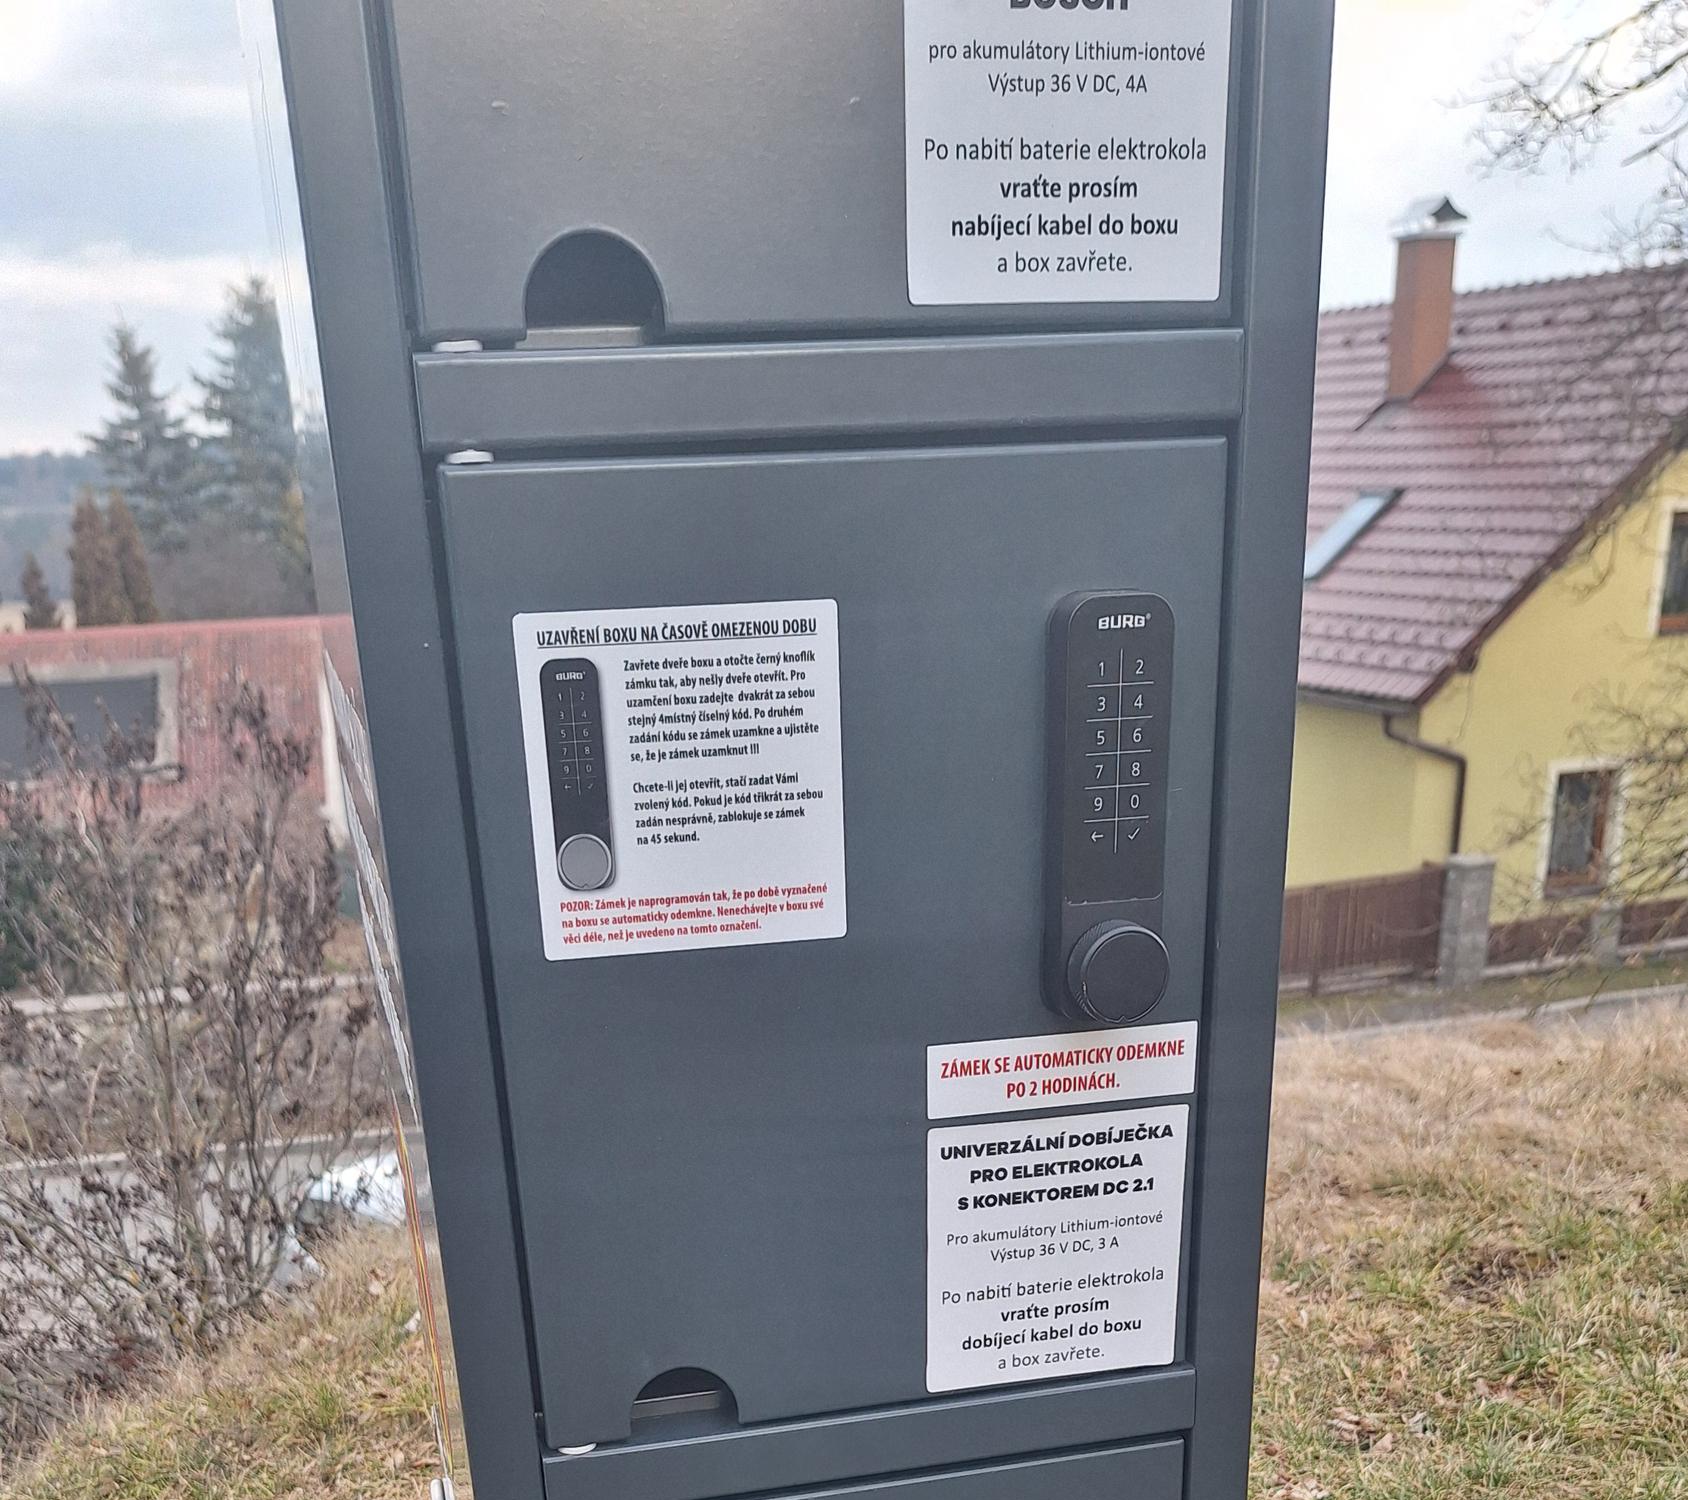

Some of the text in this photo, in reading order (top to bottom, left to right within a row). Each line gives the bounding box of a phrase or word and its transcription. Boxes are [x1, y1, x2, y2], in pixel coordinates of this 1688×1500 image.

[929, 39, 1205, 65] pro akumulátory Lithium-iontové
[988, 72, 1147, 97] Výstup 36 V DC, 4A
[925, 137, 1206, 160] Po nabití baterie elektrokola
[1000, 173, 1137, 204] vraťte prosím
[952, 213, 1178, 241] nabíjecí kabel do boxu
[997, 250, 1132, 273] a box zavřete.
[536, 618, 817, 646] UZAVŘENÍ BOXU NA ČASOVĚ OMEZENOU DOBU
[623, 650, 816, 672] Zavřete dveře boxu a otočte černý knoflík
[1098, 659, 1144, 677] 1 2
[625, 669, 806, 690] zámku tak, aby nešly dveře otevřít. Pro
[1097, 694, 1143, 711] 3 4
[1096, 728, 1142, 745] 5 6
[1095, 762, 1140, 779] 7 8
[1094, 794, 1139, 811] 9 0
[636, 830, 700, 846] na 45 sekund.
[560, 882, 828, 913] POZOR: Zámek je naprogramován tak, že po době vyznačené
[941, 1039, 1185, 1079] ZÁMEK SE AUTOMATICKY ODEMKNE
[1007, 1071, 1120, 1099] PO 2 HODINÁCH.
[940, 1124, 1174, 1160] UNIVERZÁLNÍ DOBÍJEČKA
[970, 1153, 1143, 1184] PRO ELEKTROKOLA
[957, 1177, 1154, 1211] S KONEKTOREM DC 2.1
[947, 1210, 1163, 1246] Pro akumulátory Lithium-iontové
[990, 1236, 1119, 1263] Výstup 36 V DC, 3 A
[942, 1266, 1164, 1305] Po nabití baterie elektrokola
[1000, 1297, 1109, 1322] vraťte prosím
[962, 1319, 1141, 1350] dobíjecí kabel do boxu
[998, 1346, 1104, 1369] a box zavřete.
